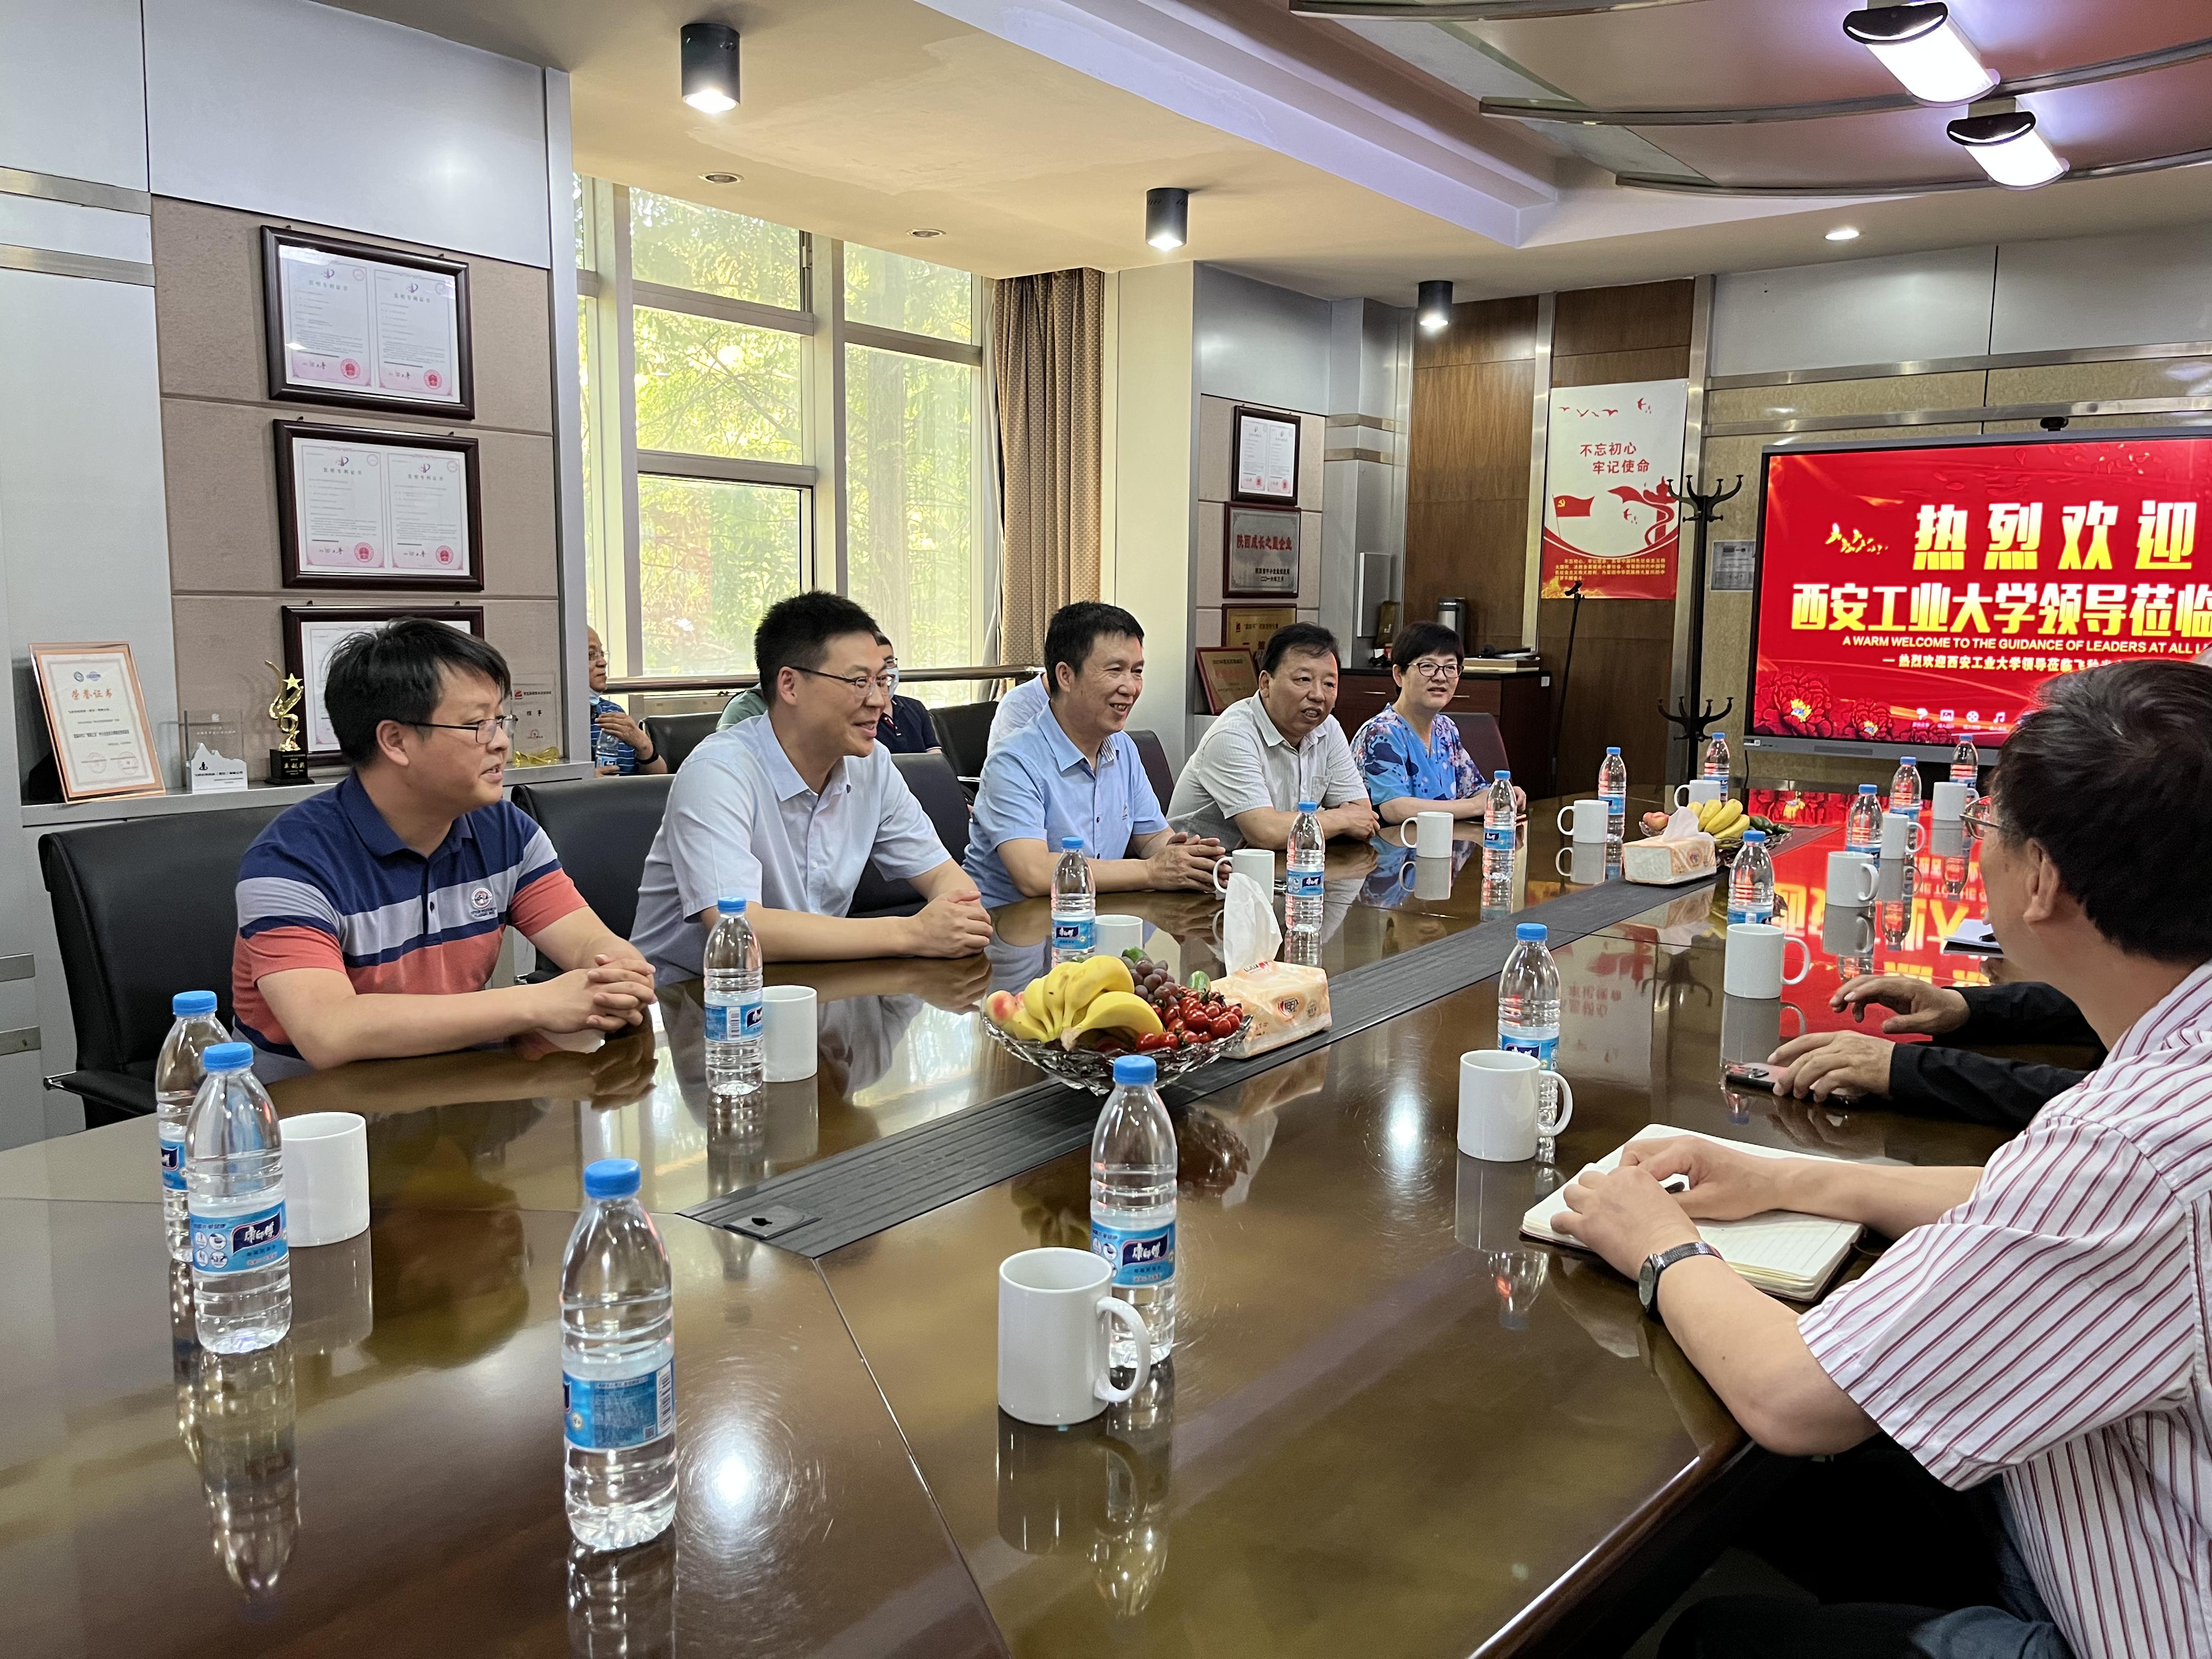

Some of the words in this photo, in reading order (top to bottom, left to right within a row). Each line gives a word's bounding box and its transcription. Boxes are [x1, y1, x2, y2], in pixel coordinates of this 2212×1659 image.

[1579, 441, 1637, 457] 不忘初心
[1592, 459, 1650, 475] 牢记使命
[1912, 500, 2197, 571] 热烈欢迎
[1791, 582, 2212, 637] 西安工业大学领导莅临
[1842, 636, 1852, 646] A
[1853, 636, 1889, 647] WARM
[1891, 636, 1951, 648] WELCOME
[1952, 637, 1970, 648] TO
[1972, 638, 1996, 650] THE
[1998, 638, 2064, 651] GUIDANCE
[2066, 640, 2085, 651] OF
[2086, 640, 2146, 653] LEADERS
[2148, 642, 2167, 653] AT
[2168, 642, 2193, 654] ALL
